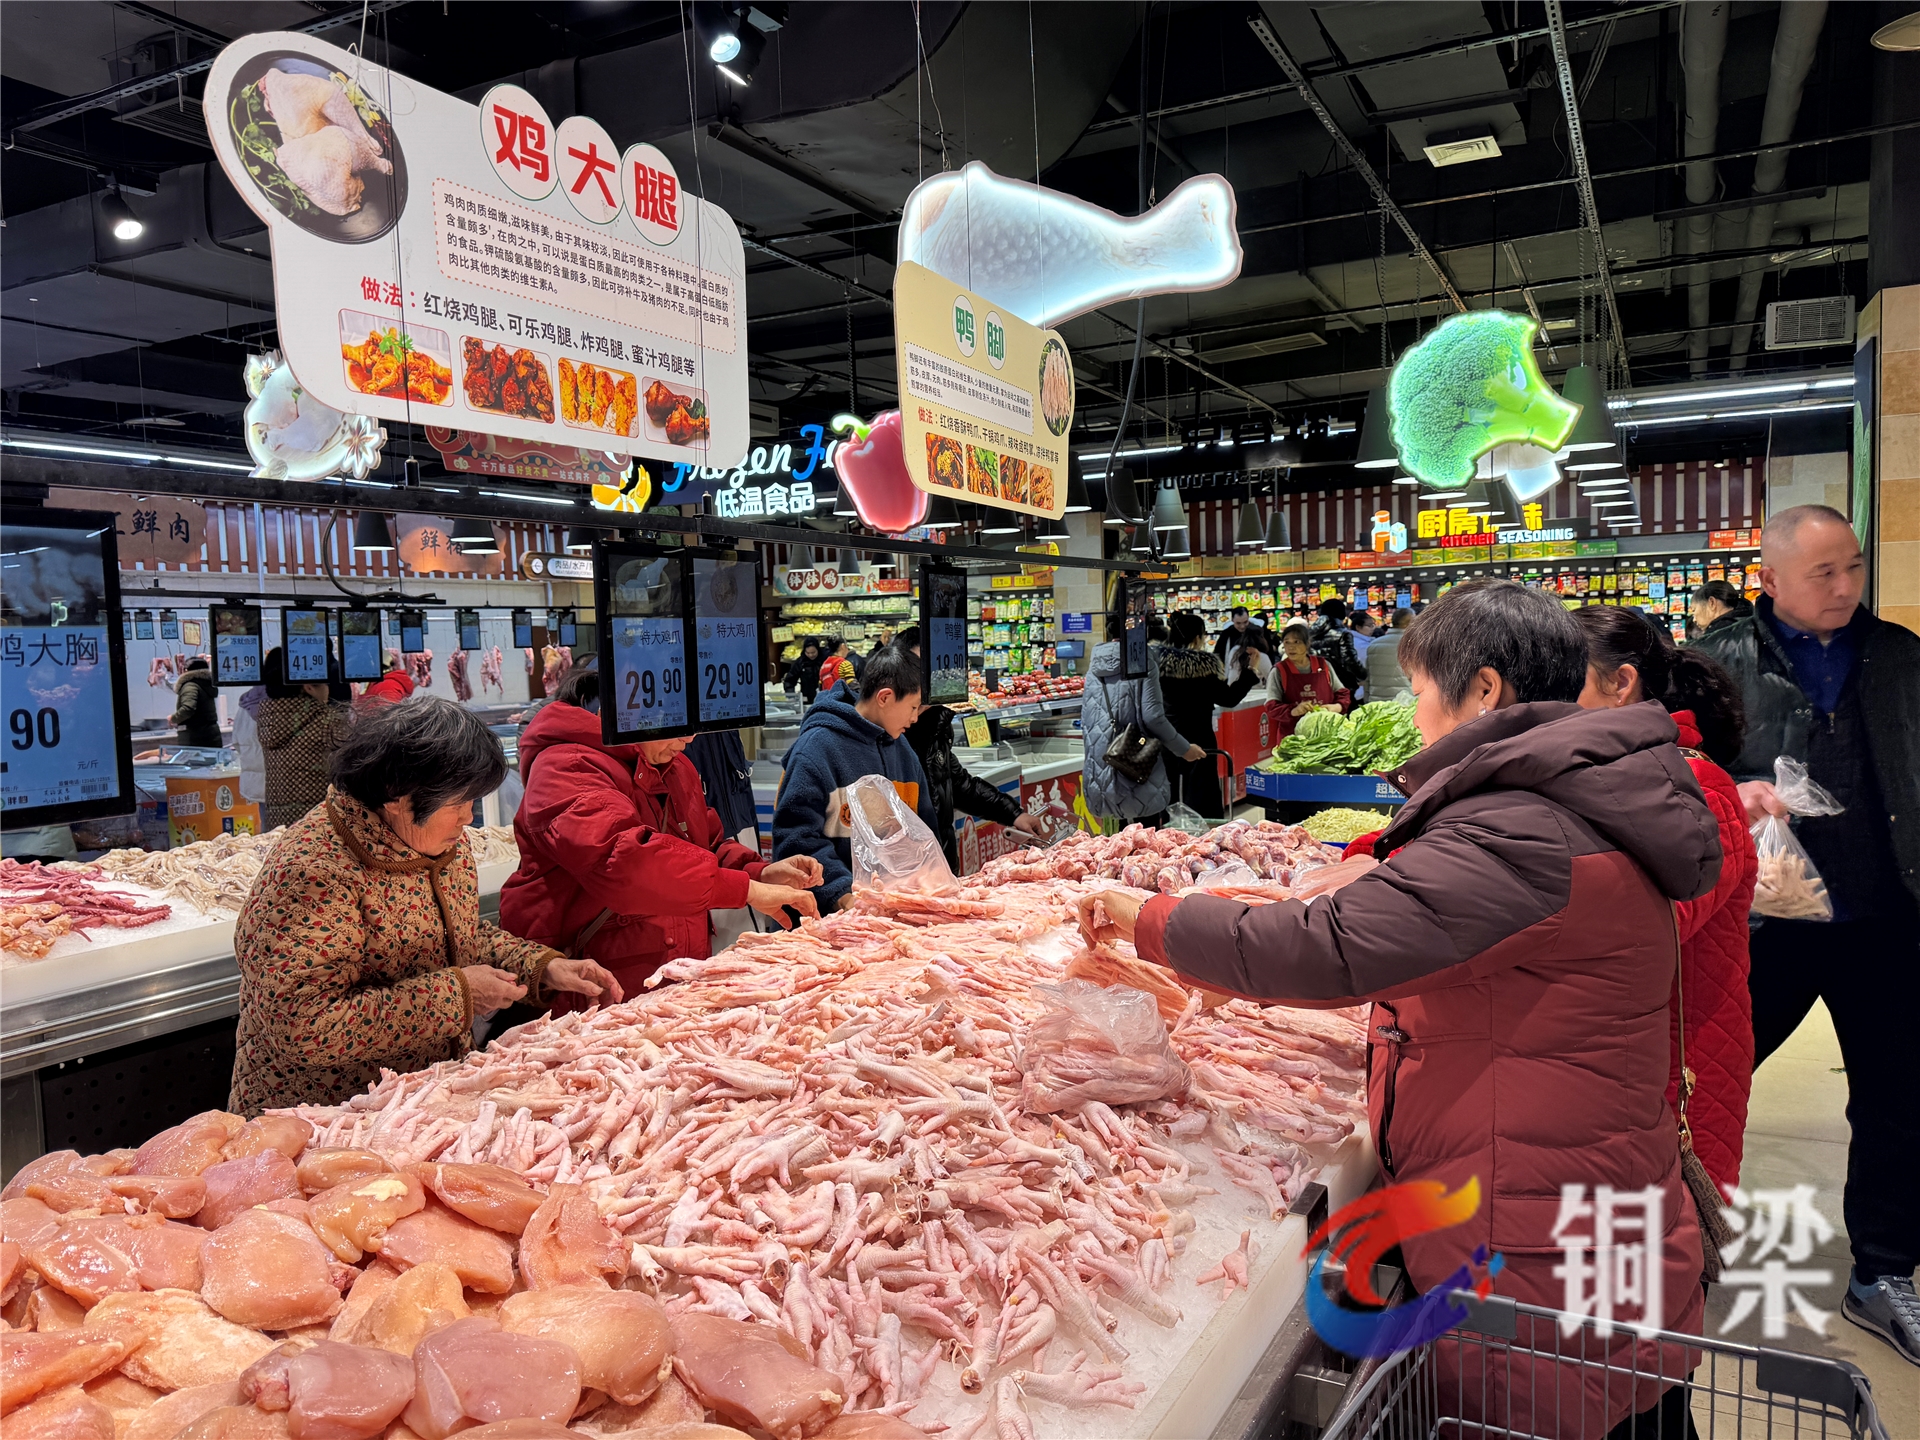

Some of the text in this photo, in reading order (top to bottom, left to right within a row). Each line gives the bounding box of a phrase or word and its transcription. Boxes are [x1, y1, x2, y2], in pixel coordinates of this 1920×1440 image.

[493, 103, 679, 233] 鸡大腿
[422, 291, 695, 378] 红烧鸡腿、可乐鸡腿、炸鸡腿、蜜汁鸡腿等
[955, 305, 1004, 361] 鸭脚
[714, 481, 815, 518] 低温食品
[1417, 502, 1543, 539] 厨房味
[1441, 527, 1575, 548] KITCHEN SEASONING
[788, 571, 837, 587] 钵钵鸡
[640, 629, 682, 646] 特大鸡爪
[716, 622, 756, 639] 特大鸡爪
[945, 622, 962, 641] 鸭掌
[0, 632, 99, 668] 鸡大胸
[222, 655, 256, 673] 41.90
[292, 654, 324, 671] 41.90
[936, 653, 964, 671] 1890
[625, 667, 682, 710] 29.90
[704, 661, 754, 700] 29.90
[968, 726, 989, 745] 29.90
[77, 760, 99, 770] 元/斤
